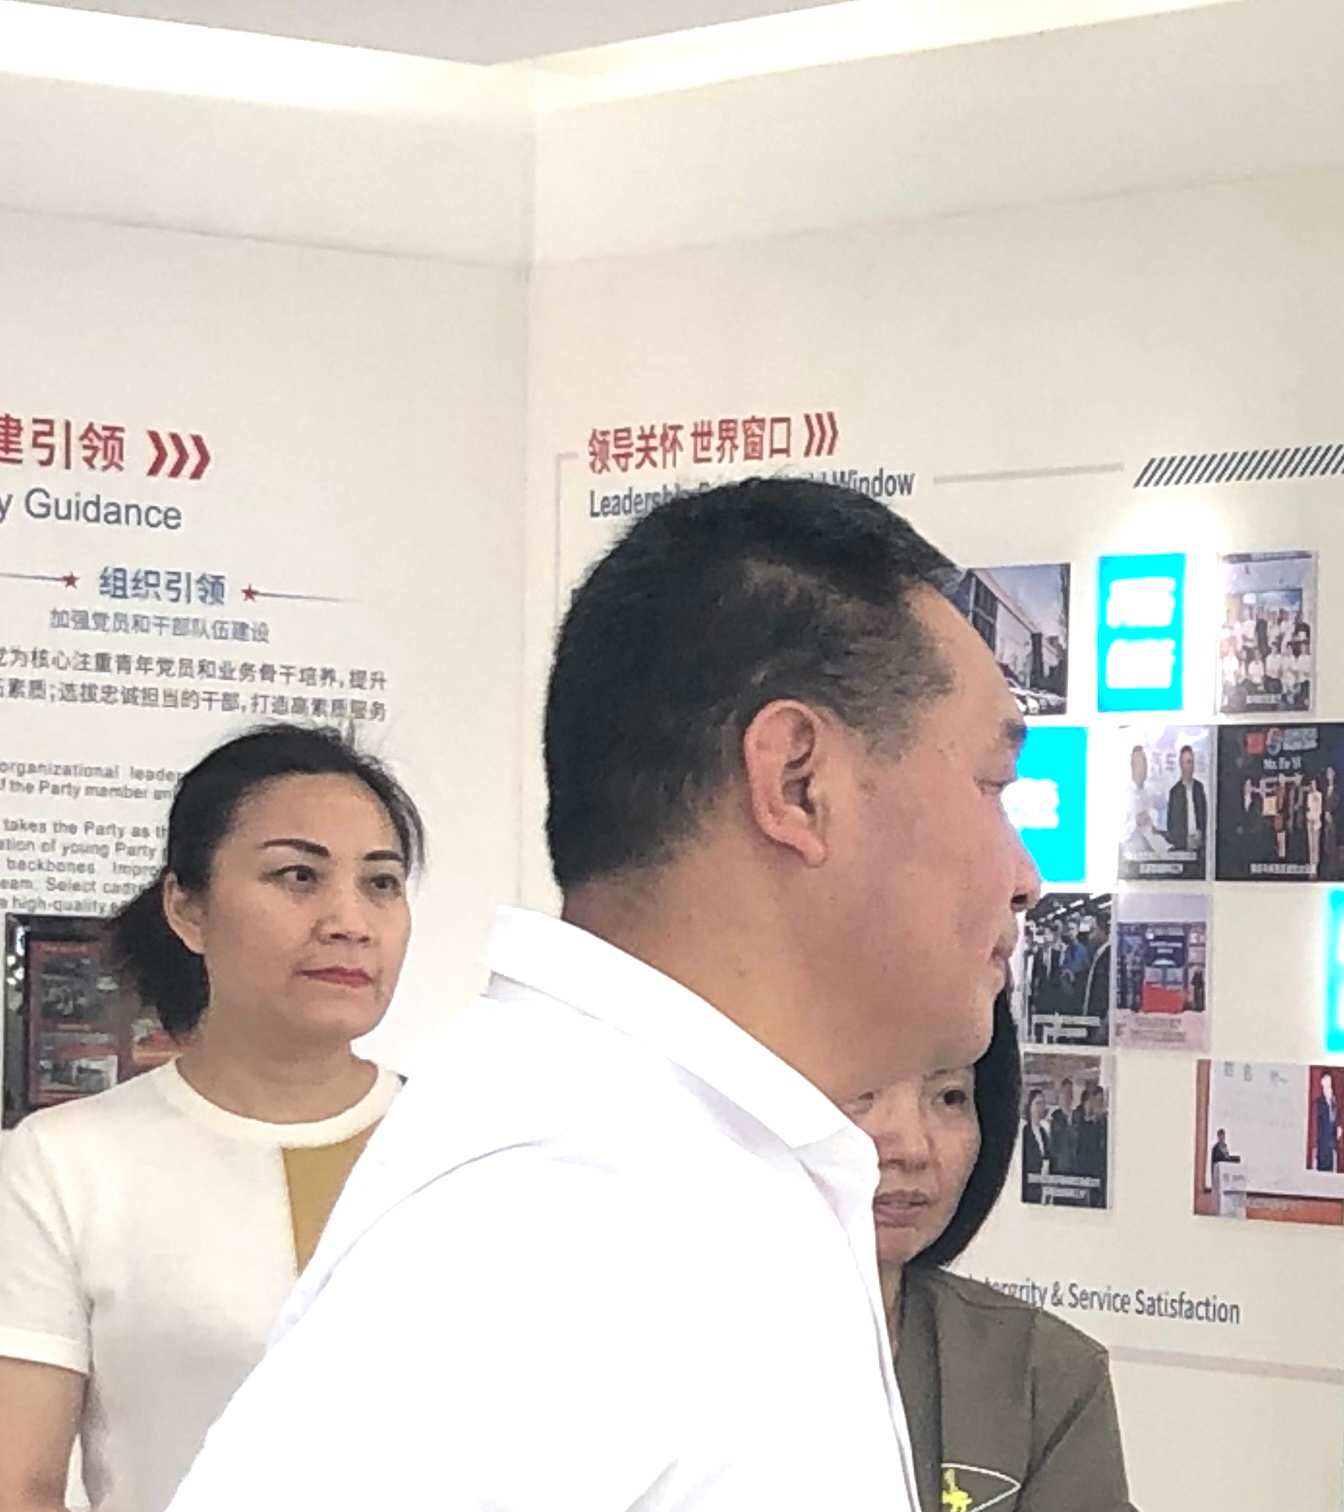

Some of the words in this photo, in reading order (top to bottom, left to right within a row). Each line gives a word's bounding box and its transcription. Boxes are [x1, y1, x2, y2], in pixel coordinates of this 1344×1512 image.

[587, 422, 684, 475] 领导关怀
[690, 414, 793, 465] 世界窗口
[24, 486, 183, 531] Guidance
[98, 565, 227, 606] 组织引领
[10, 779, 35, 794] the
[39, 779, 81, 800] Party
[4, 817, 48, 834] takes
[53, 819, 78, 836] the
[83, 820, 126, 839] Party
[131, 824, 150, 839] as
[114, 840, 158, 861] Party
[46, 876, 97, 894] Select
[1050, 1280, 1064, 1307] &
[1068, 1282, 1131, 1315] Service
[1136, 1288, 1241, 1326] Satisfaction
